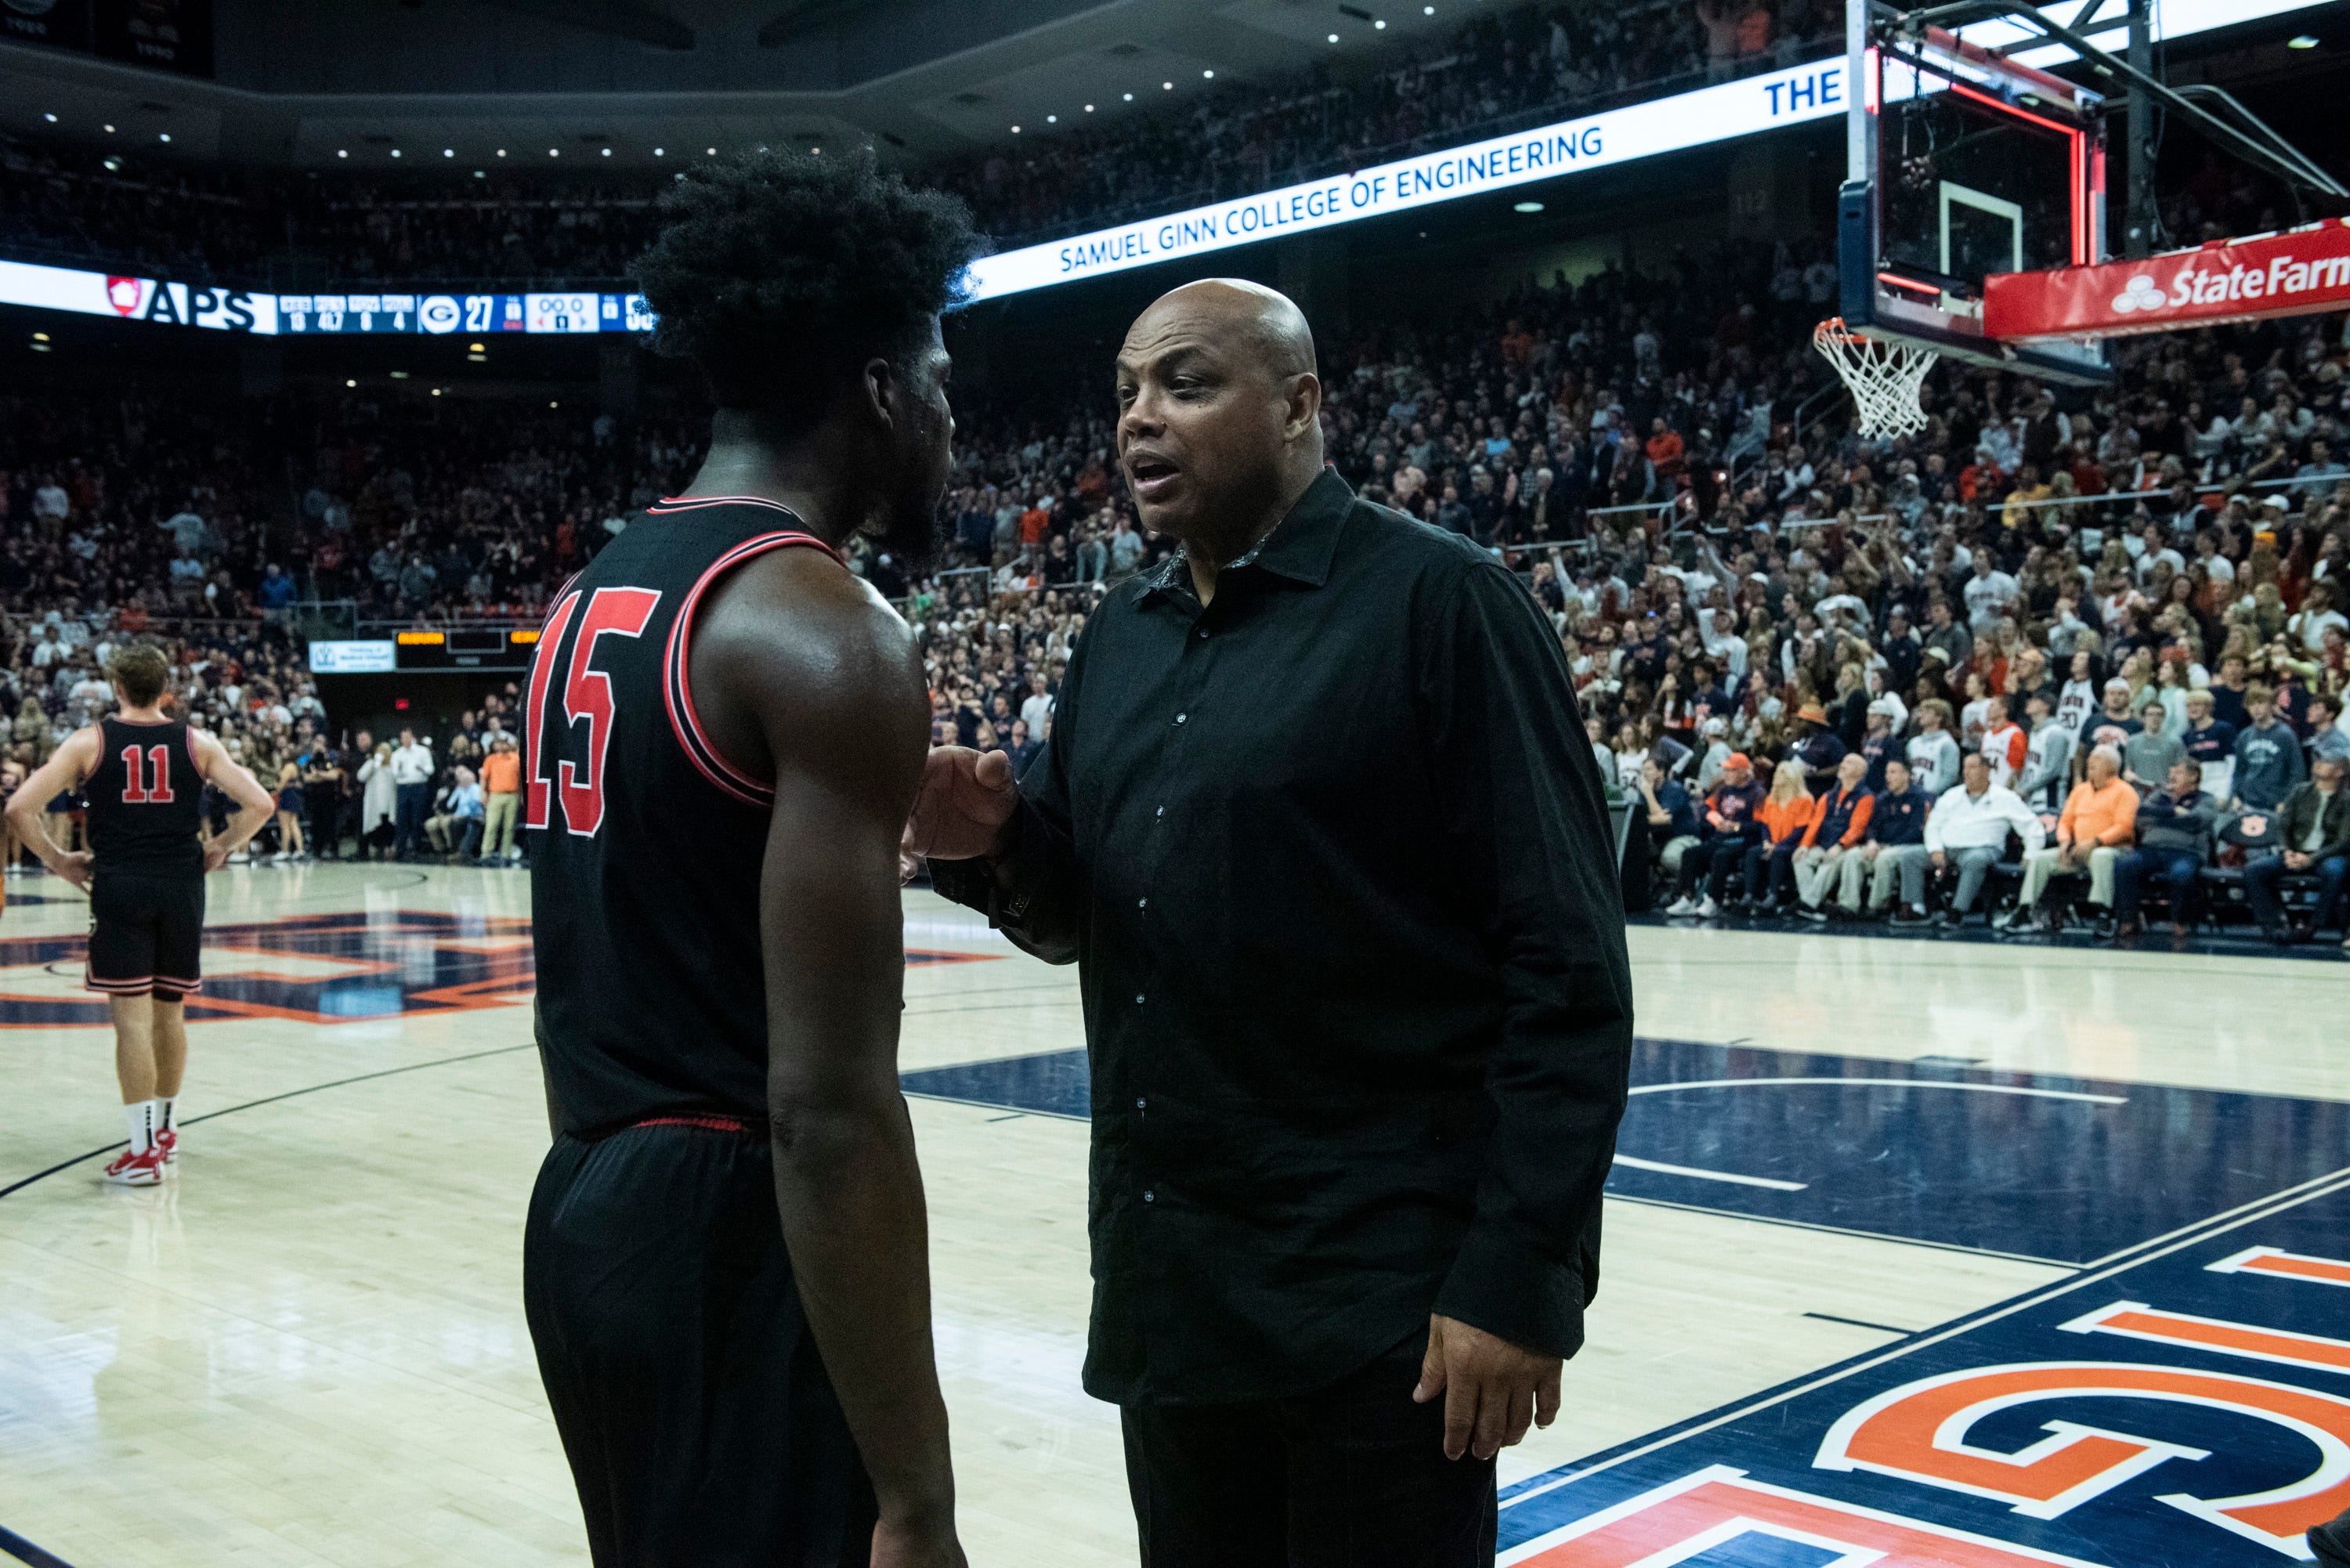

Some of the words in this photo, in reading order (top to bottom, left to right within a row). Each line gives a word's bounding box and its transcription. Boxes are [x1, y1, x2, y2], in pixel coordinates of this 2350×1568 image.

[1765, 70, 1841, 115] THE
[1061, 233, 1150, 272] SAMUEL
[1159, 215, 1217, 249] GINN
[1226, 187, 1341, 234] COLLEGE
[1351, 176, 1386, 207] OF
[1397, 127, 1603, 197] ENGINEERING
[465, 296, 494, 331] 27
[526, 586, 663, 839] 15
[121, 744, 175, 804] 11
